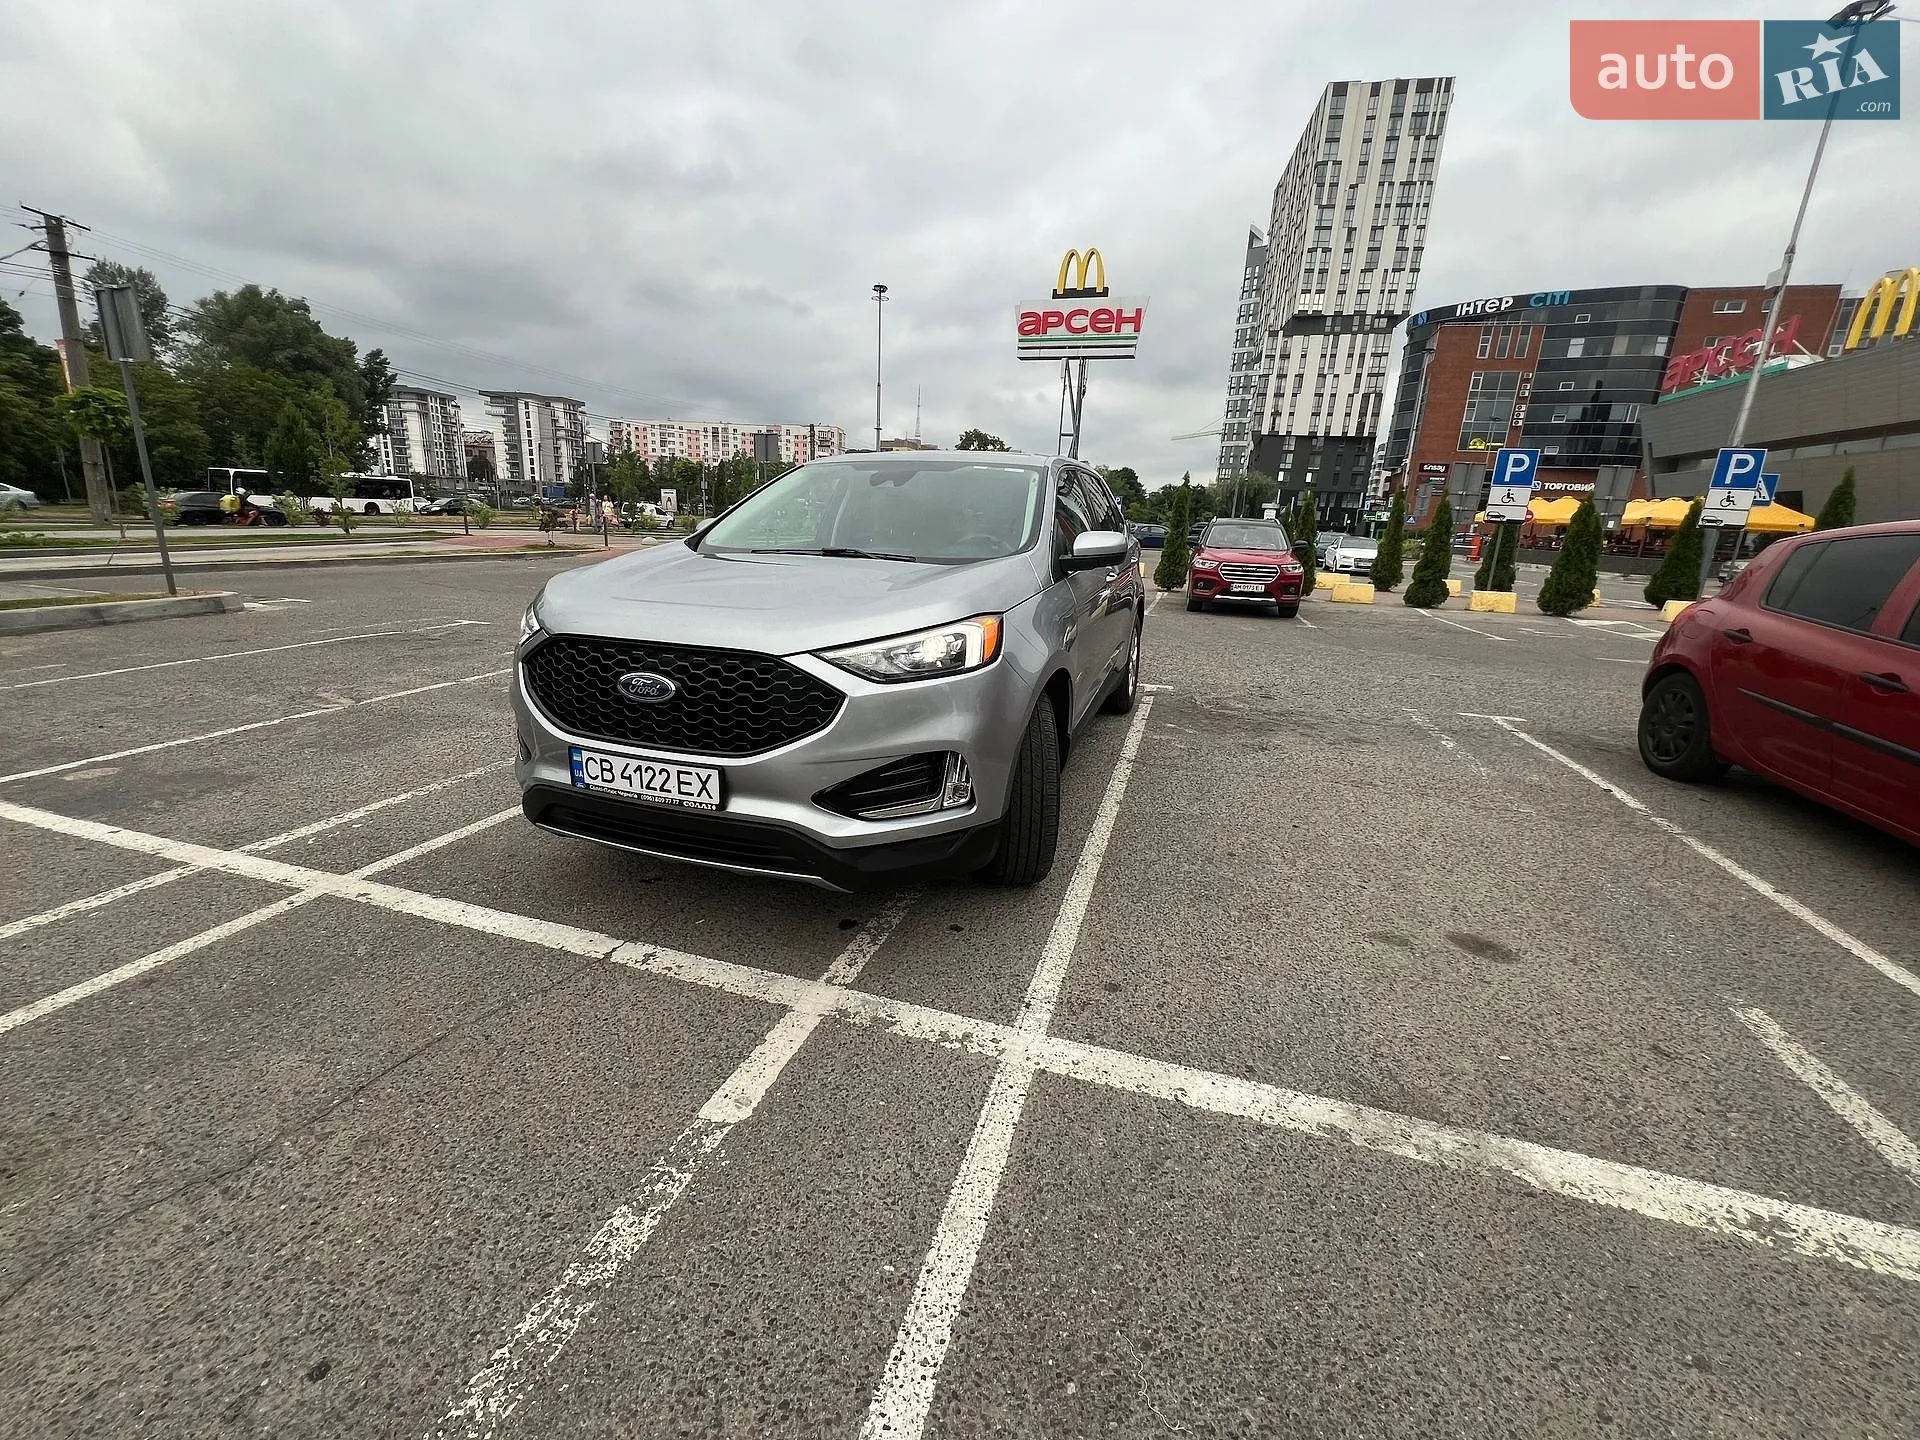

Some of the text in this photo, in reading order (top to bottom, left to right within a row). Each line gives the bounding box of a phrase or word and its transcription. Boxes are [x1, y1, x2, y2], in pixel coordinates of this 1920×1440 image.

[1504, 453, 1530, 482] P
[1724, 453, 1755, 484] P
[1543, 482, 1596, 492] ТОРГОВИЙ
[629, 678, 660, 695] Ford
[574, 769, 584, 778] UA
[585, 756, 714, 800] CB 4122 EX
